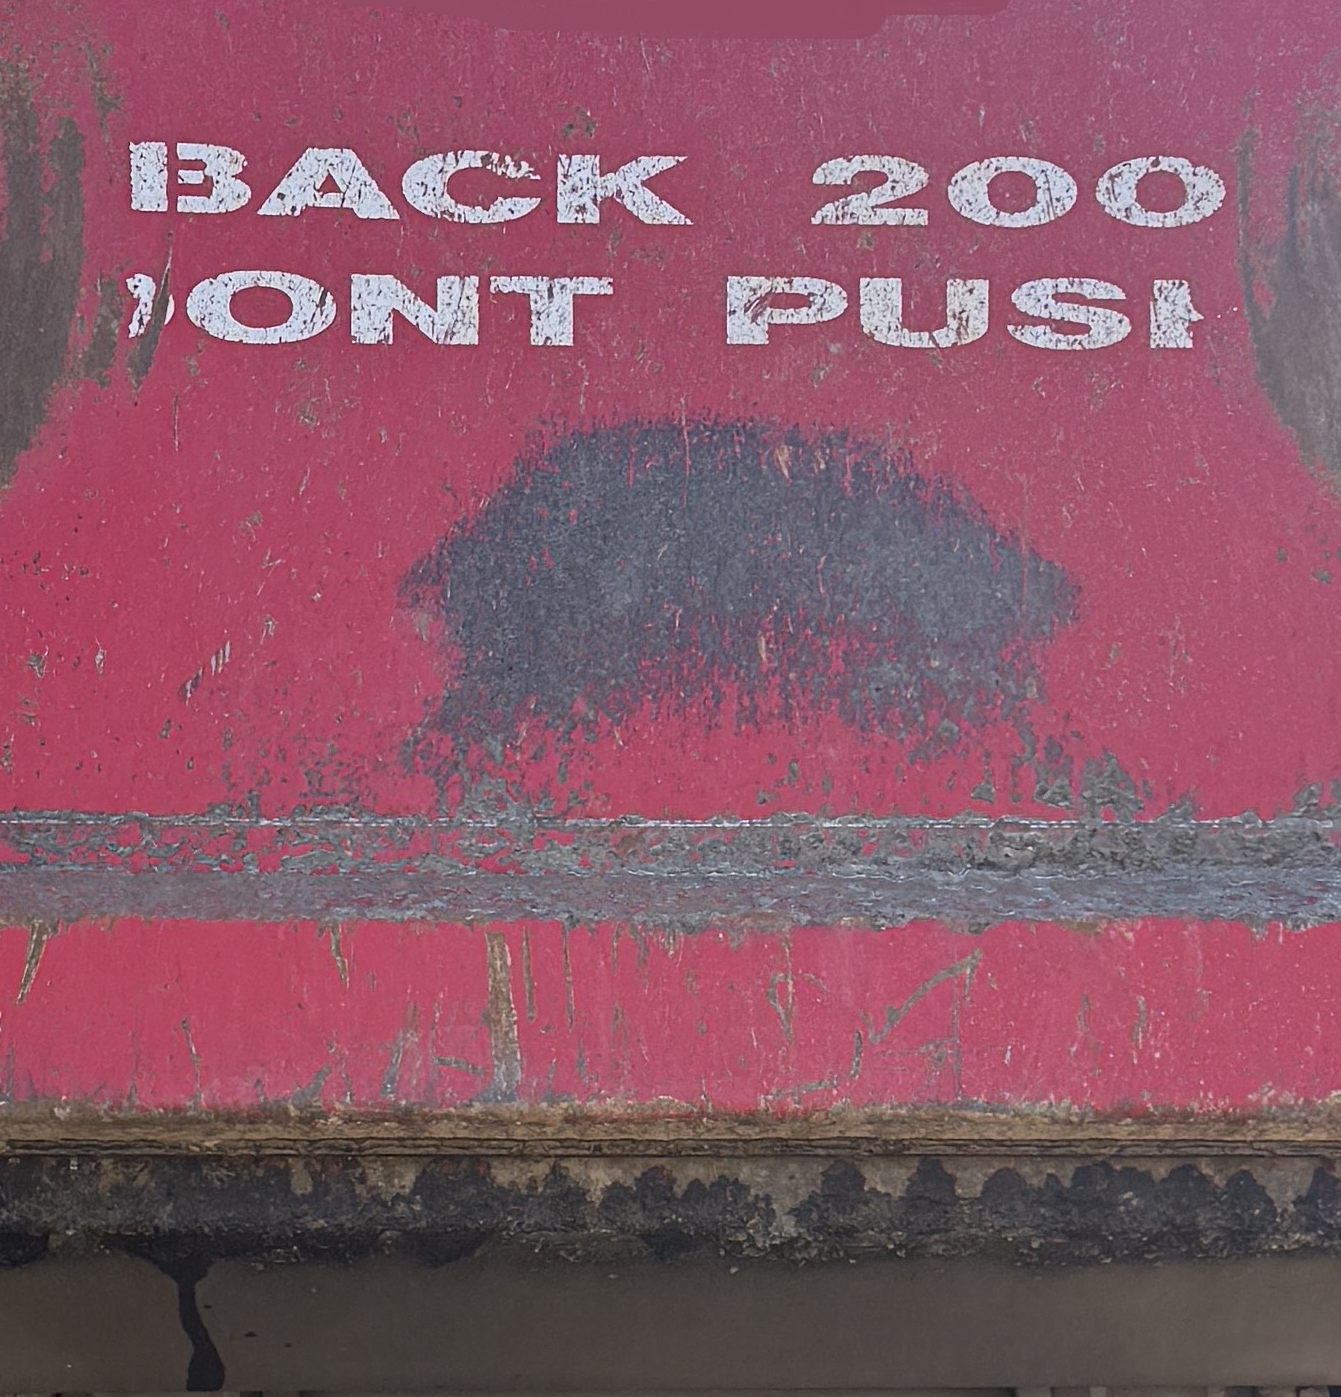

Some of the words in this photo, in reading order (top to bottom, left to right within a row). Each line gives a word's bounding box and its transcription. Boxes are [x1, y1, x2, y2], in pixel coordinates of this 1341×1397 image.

[129, 141, 694, 225] BACK
[811, 154, 1226, 228] 200
[125, 270, 614, 346] ONT
